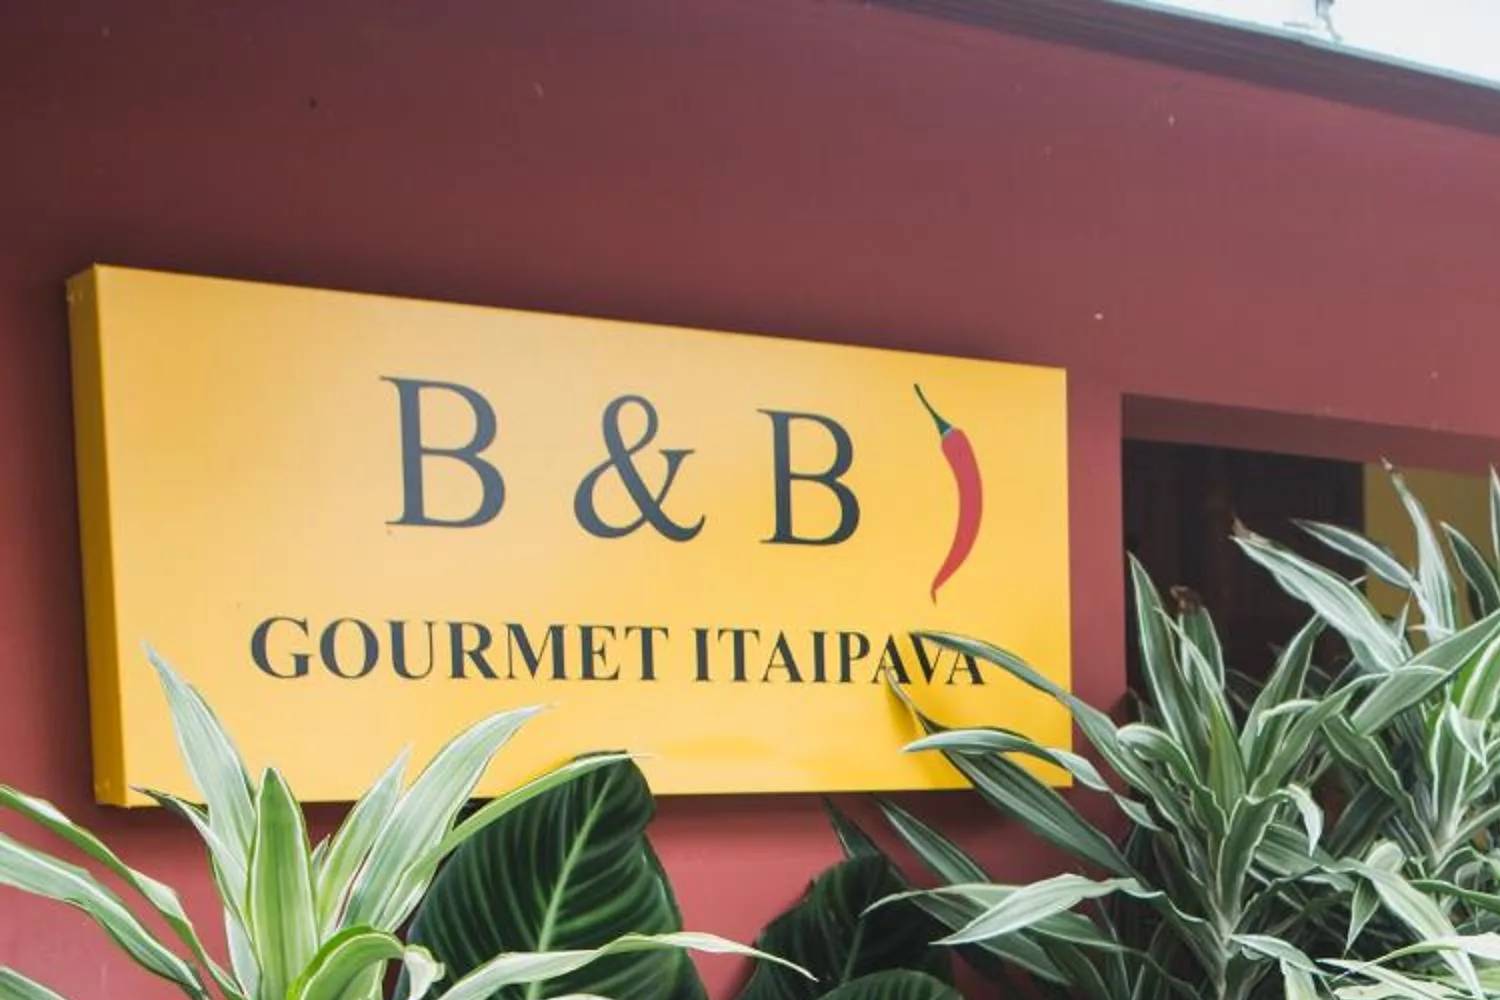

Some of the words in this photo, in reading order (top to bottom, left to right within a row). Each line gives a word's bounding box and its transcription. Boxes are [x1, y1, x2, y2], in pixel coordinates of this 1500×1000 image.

[380, 376, 506, 528] B
[573, 395, 706, 542] &
[757, 409, 862, 547] B
[250, 616, 669, 684] GOURMET
[693, 629, 987, 687] ITAIPAVA
